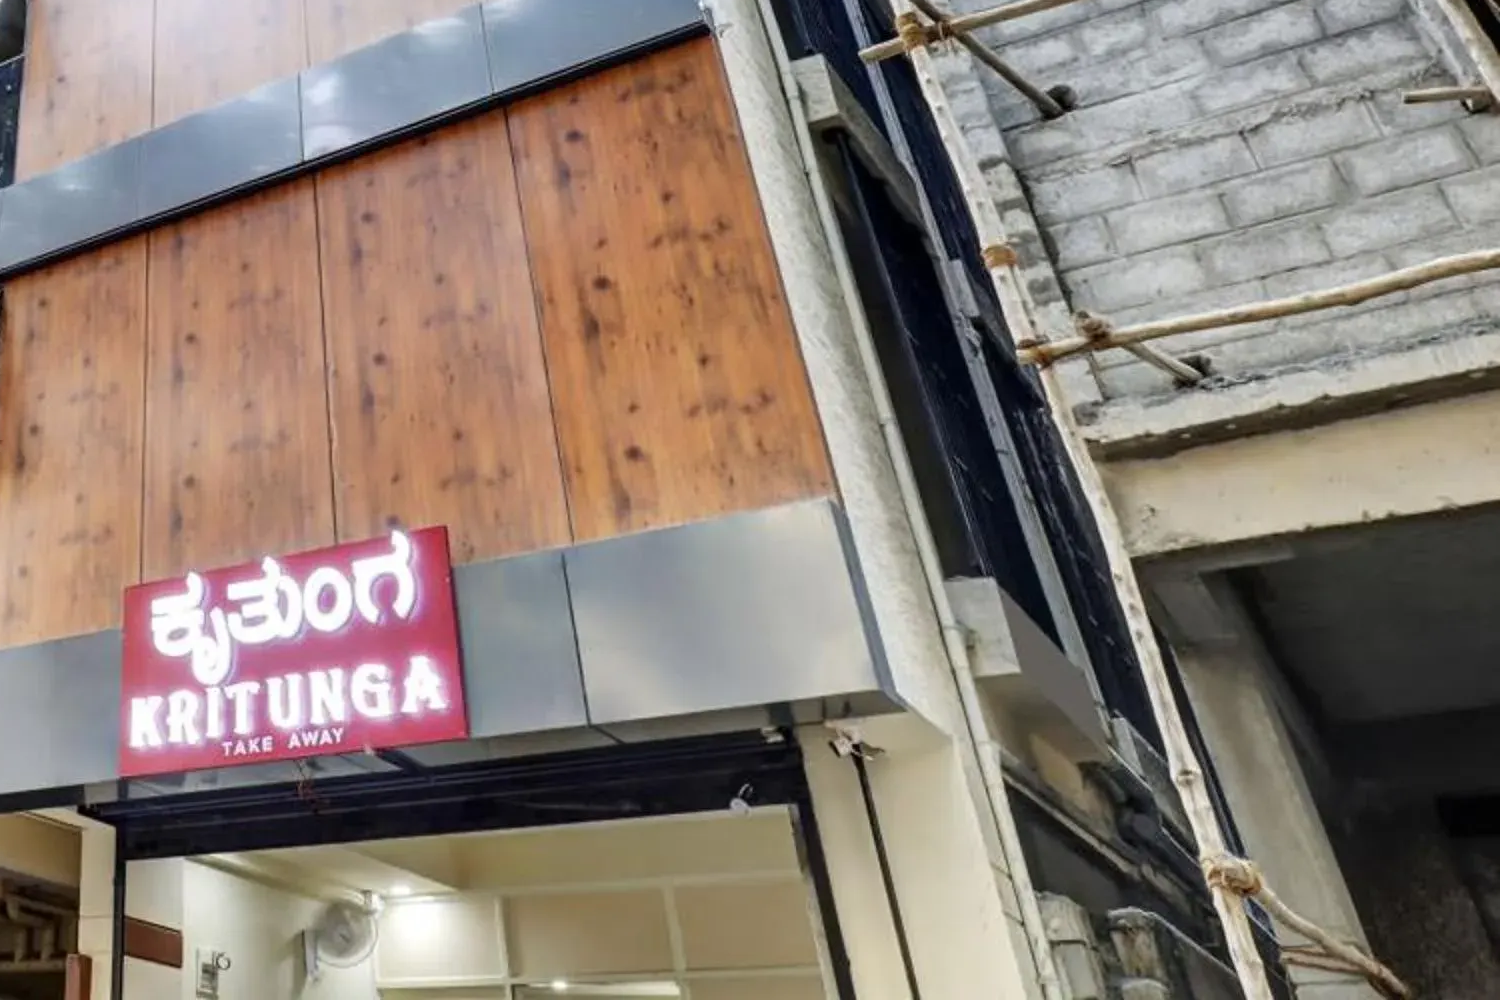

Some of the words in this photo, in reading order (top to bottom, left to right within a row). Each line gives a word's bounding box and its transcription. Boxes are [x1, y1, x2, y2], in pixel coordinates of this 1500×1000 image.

[130, 655, 448, 748] KRITUNGA
[222, 736, 273, 757] TAKE
[288, 727, 344, 750] AWAY
